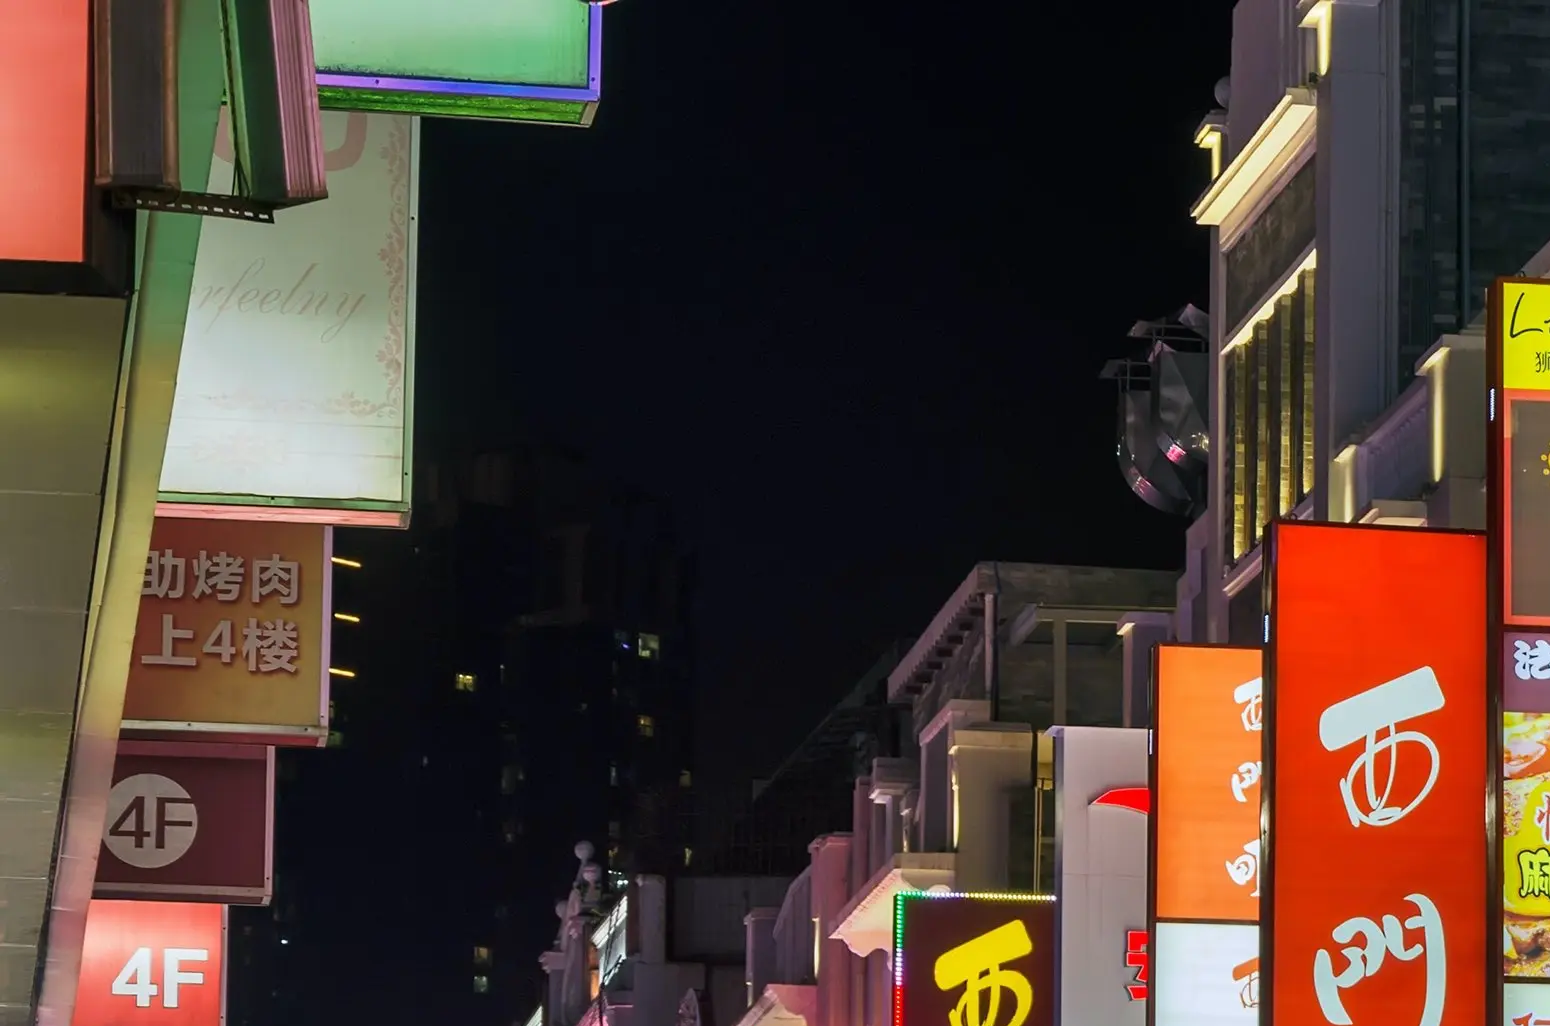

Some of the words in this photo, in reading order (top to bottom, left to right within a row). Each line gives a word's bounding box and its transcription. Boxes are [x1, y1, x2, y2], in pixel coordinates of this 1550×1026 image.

[141, 614, 299, 674] 上4楼
[109, 795, 193, 850] 4F
[111, 947, 208, 1008] 4F
